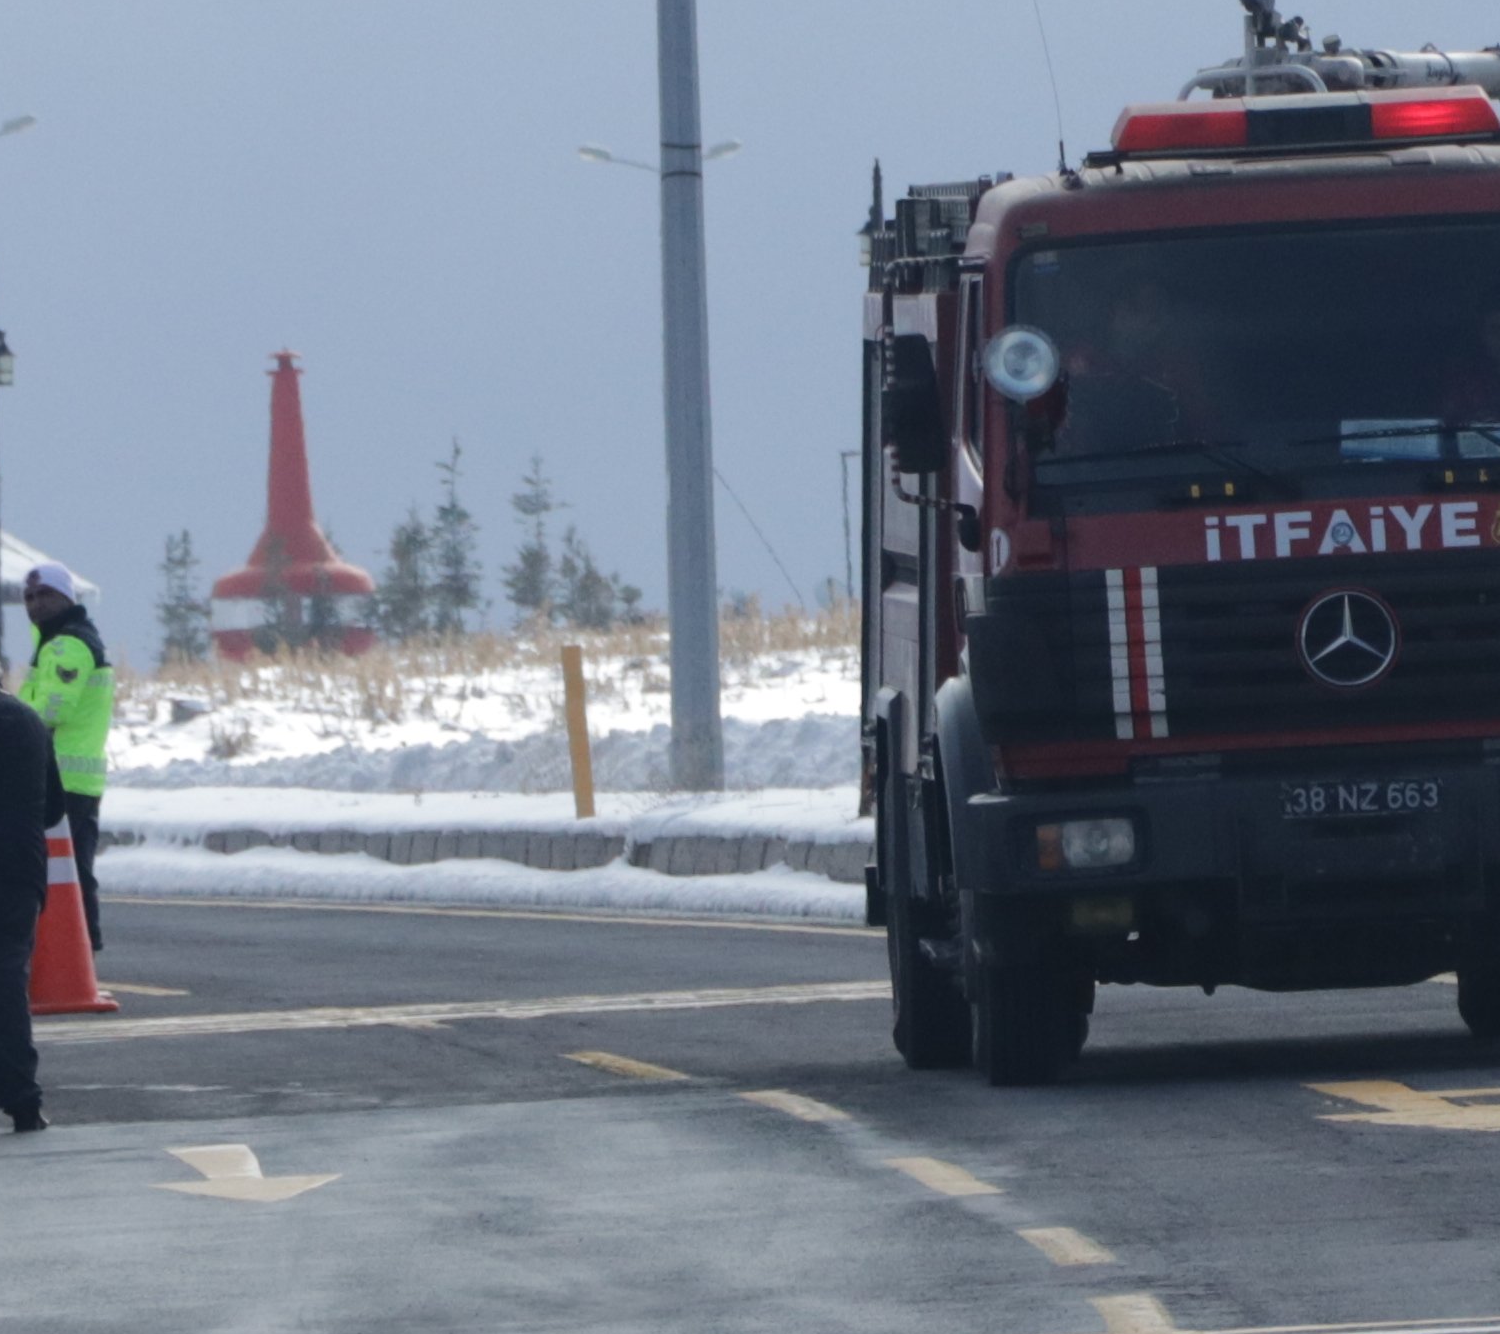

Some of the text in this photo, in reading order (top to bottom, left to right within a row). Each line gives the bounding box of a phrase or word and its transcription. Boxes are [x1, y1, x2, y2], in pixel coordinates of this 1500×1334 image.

[1292, 782, 1439, 813] 38 NZ 663
